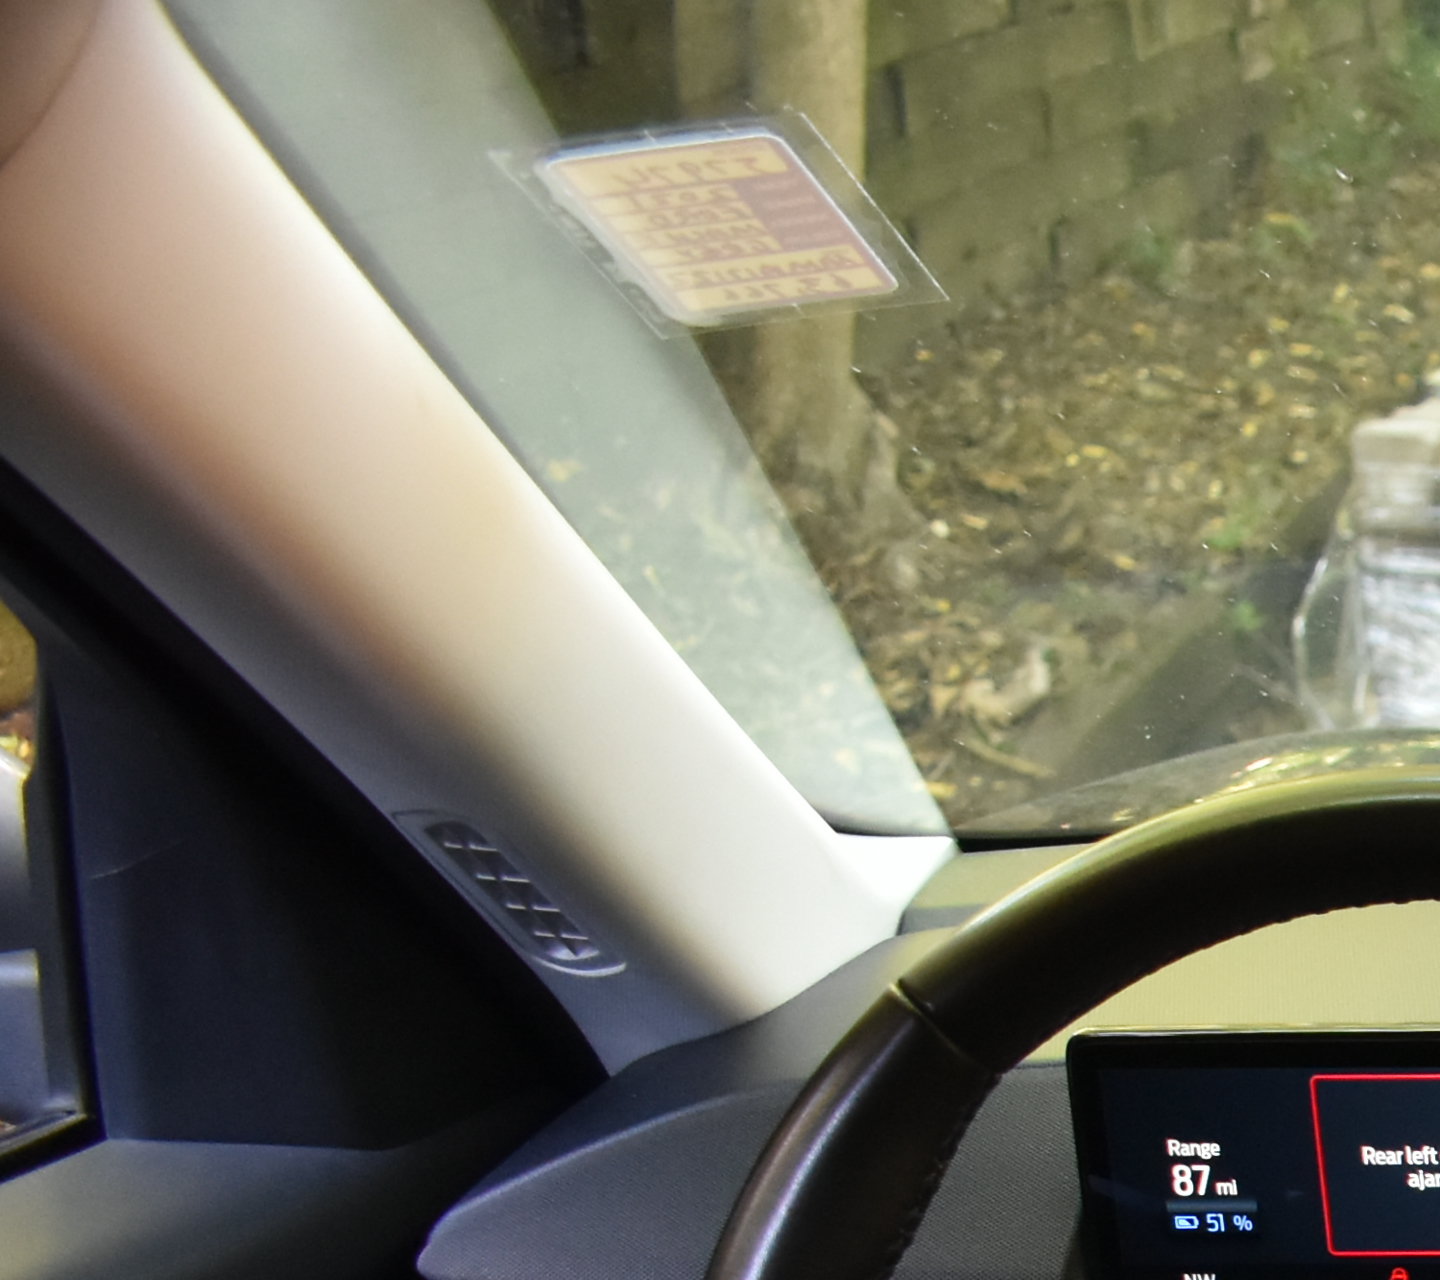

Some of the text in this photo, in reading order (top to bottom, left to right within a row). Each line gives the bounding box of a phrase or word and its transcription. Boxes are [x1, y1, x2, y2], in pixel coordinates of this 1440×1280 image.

[1167, 1138, 1221, 1159] Range
[1361, 1146, 1404, 1165] Rear
[1406, 1145, 1438, 1165] left
[1172, 1164, 1238, 1196] 87 mi
[1206, 1213, 1253, 1232] 51 %
